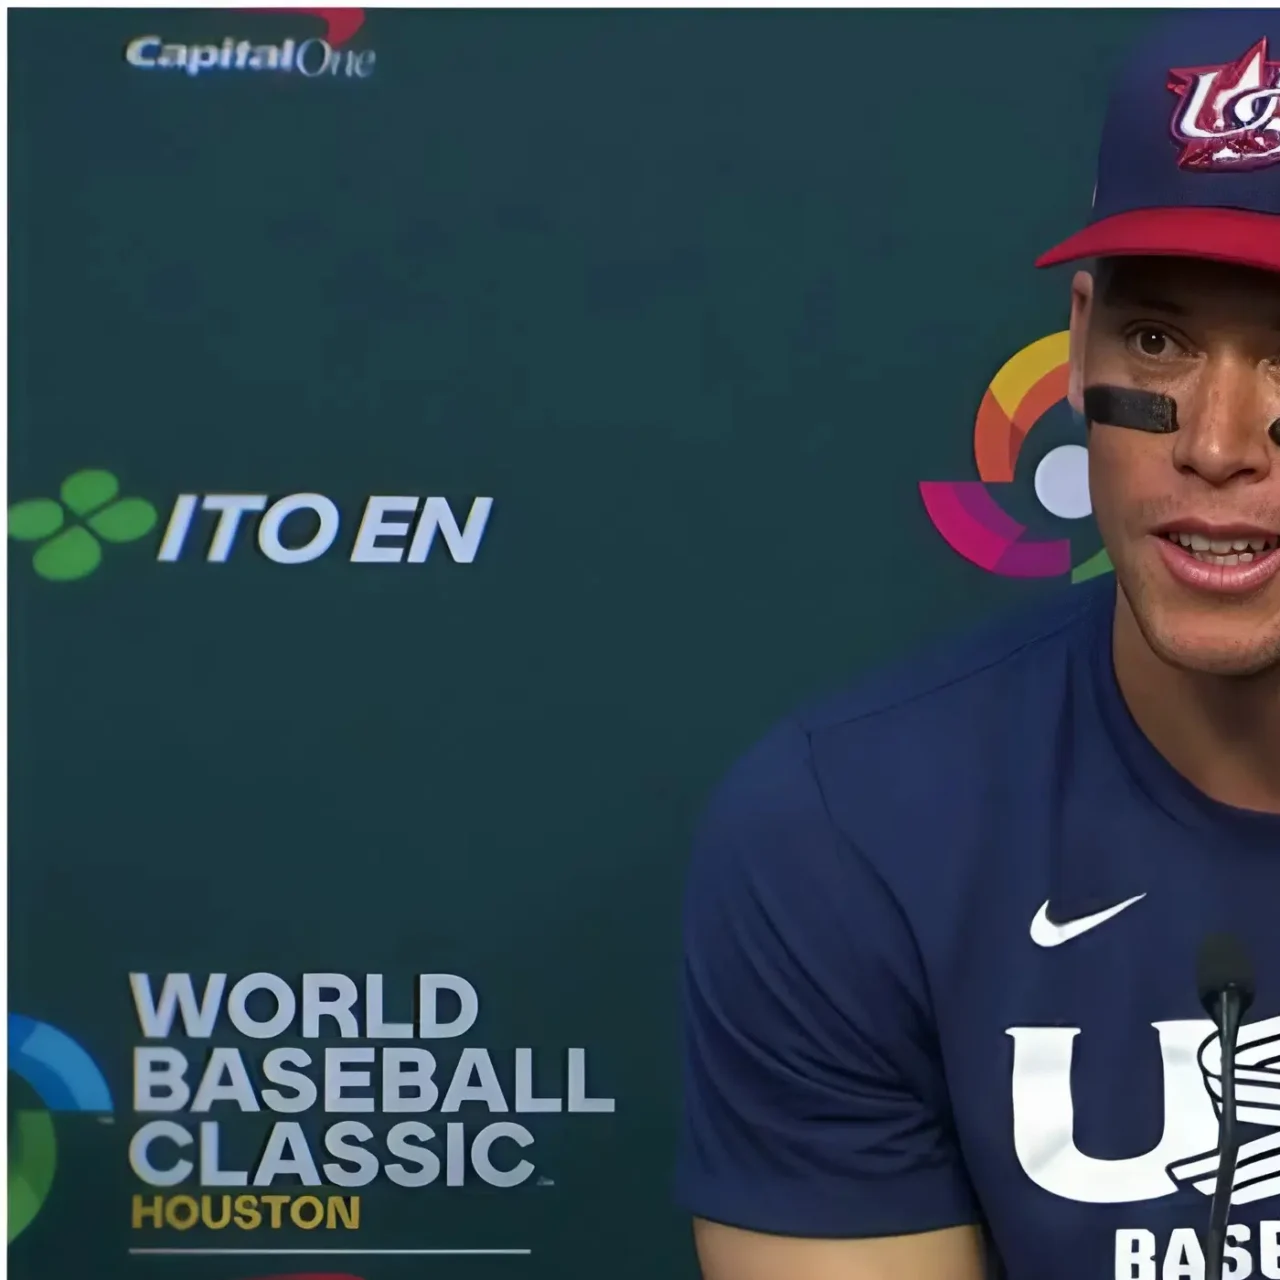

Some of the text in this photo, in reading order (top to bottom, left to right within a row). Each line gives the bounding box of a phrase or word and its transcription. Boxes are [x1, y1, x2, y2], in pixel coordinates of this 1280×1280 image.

[158, 492, 494, 565] ITO EN
[129, 972, 479, 1039] WORLD
[133, 1047, 615, 1113] BASEBALL
[128, 1121, 536, 1188] CLASSIC
[131, 1195, 361, 1230] HOUSTON
